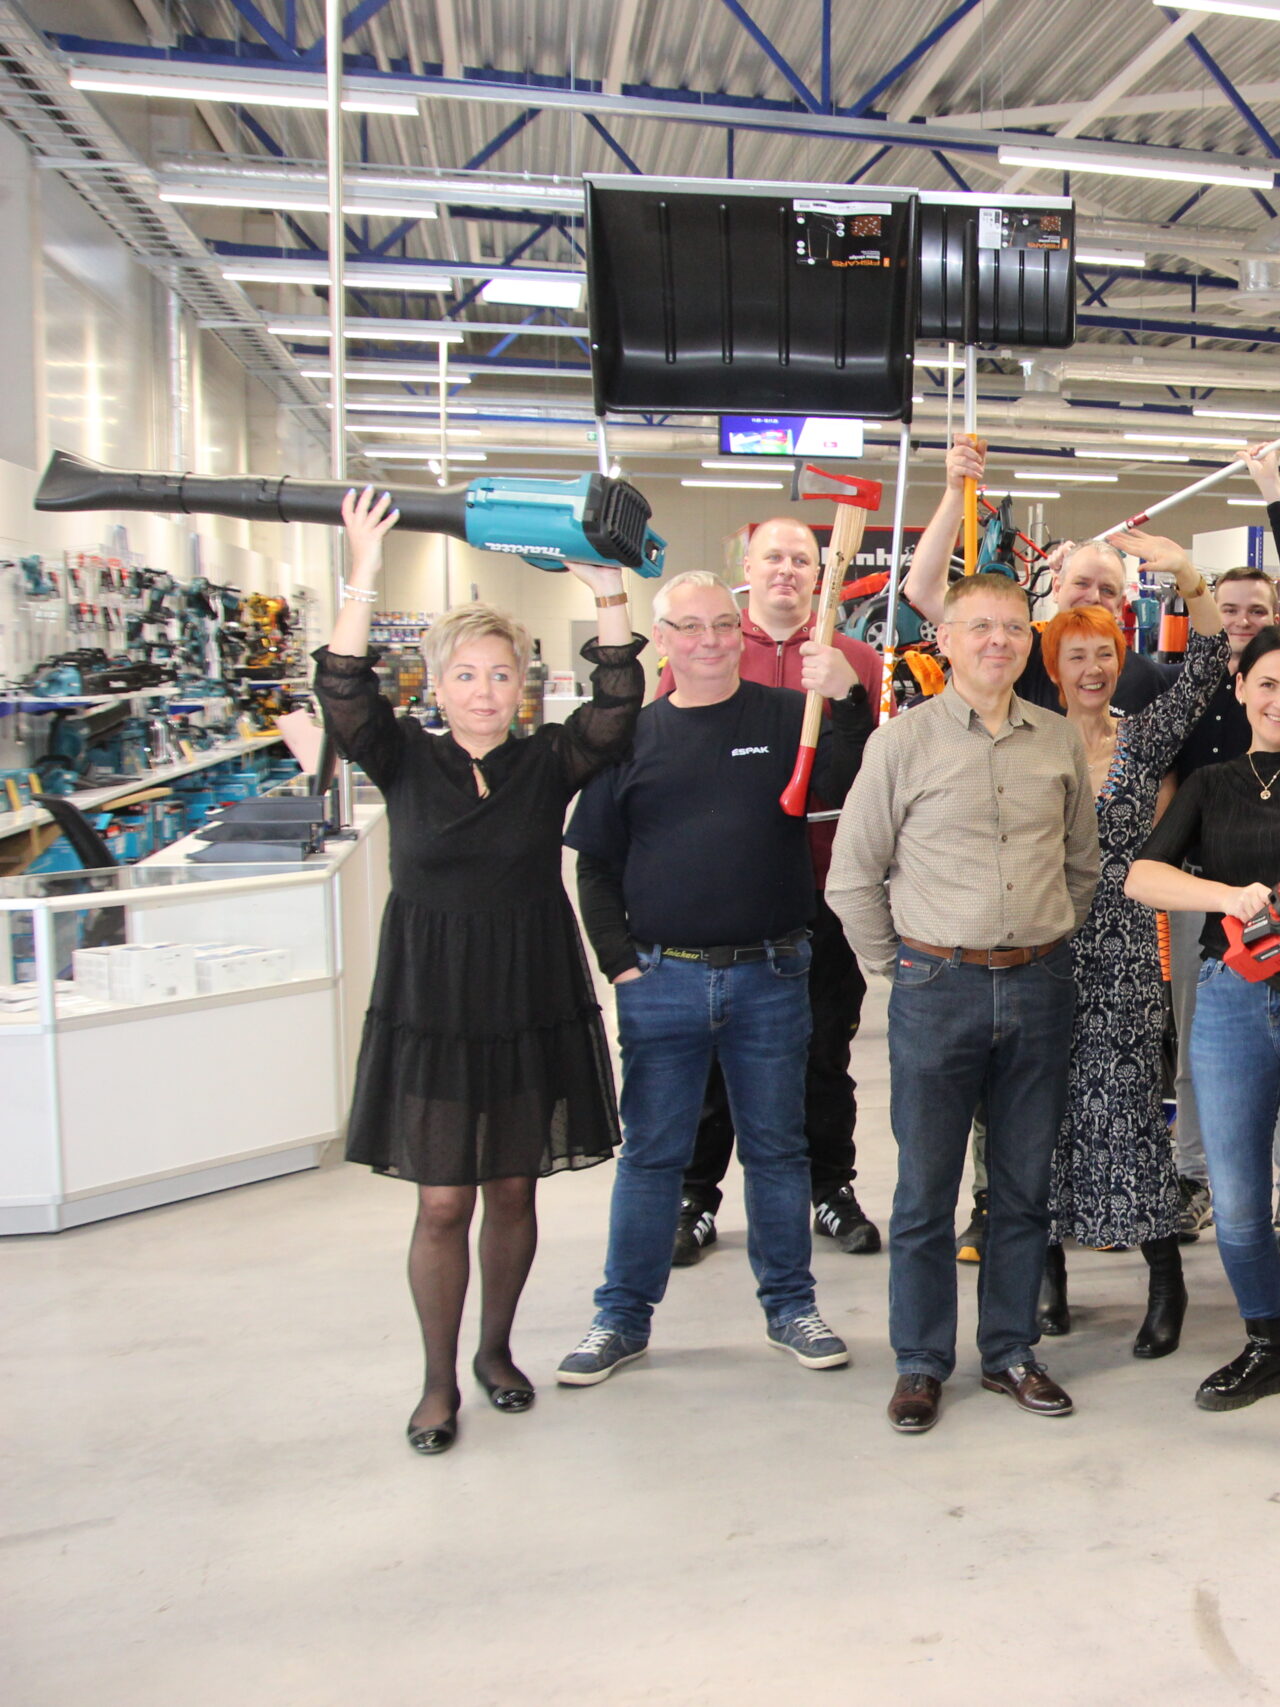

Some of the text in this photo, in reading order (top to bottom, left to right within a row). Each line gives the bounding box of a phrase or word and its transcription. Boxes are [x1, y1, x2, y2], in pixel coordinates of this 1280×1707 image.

[484, 542, 566, 557] makita
[1108, 704, 1126, 717] PAK
[731, 746, 770, 757] ESPAK
